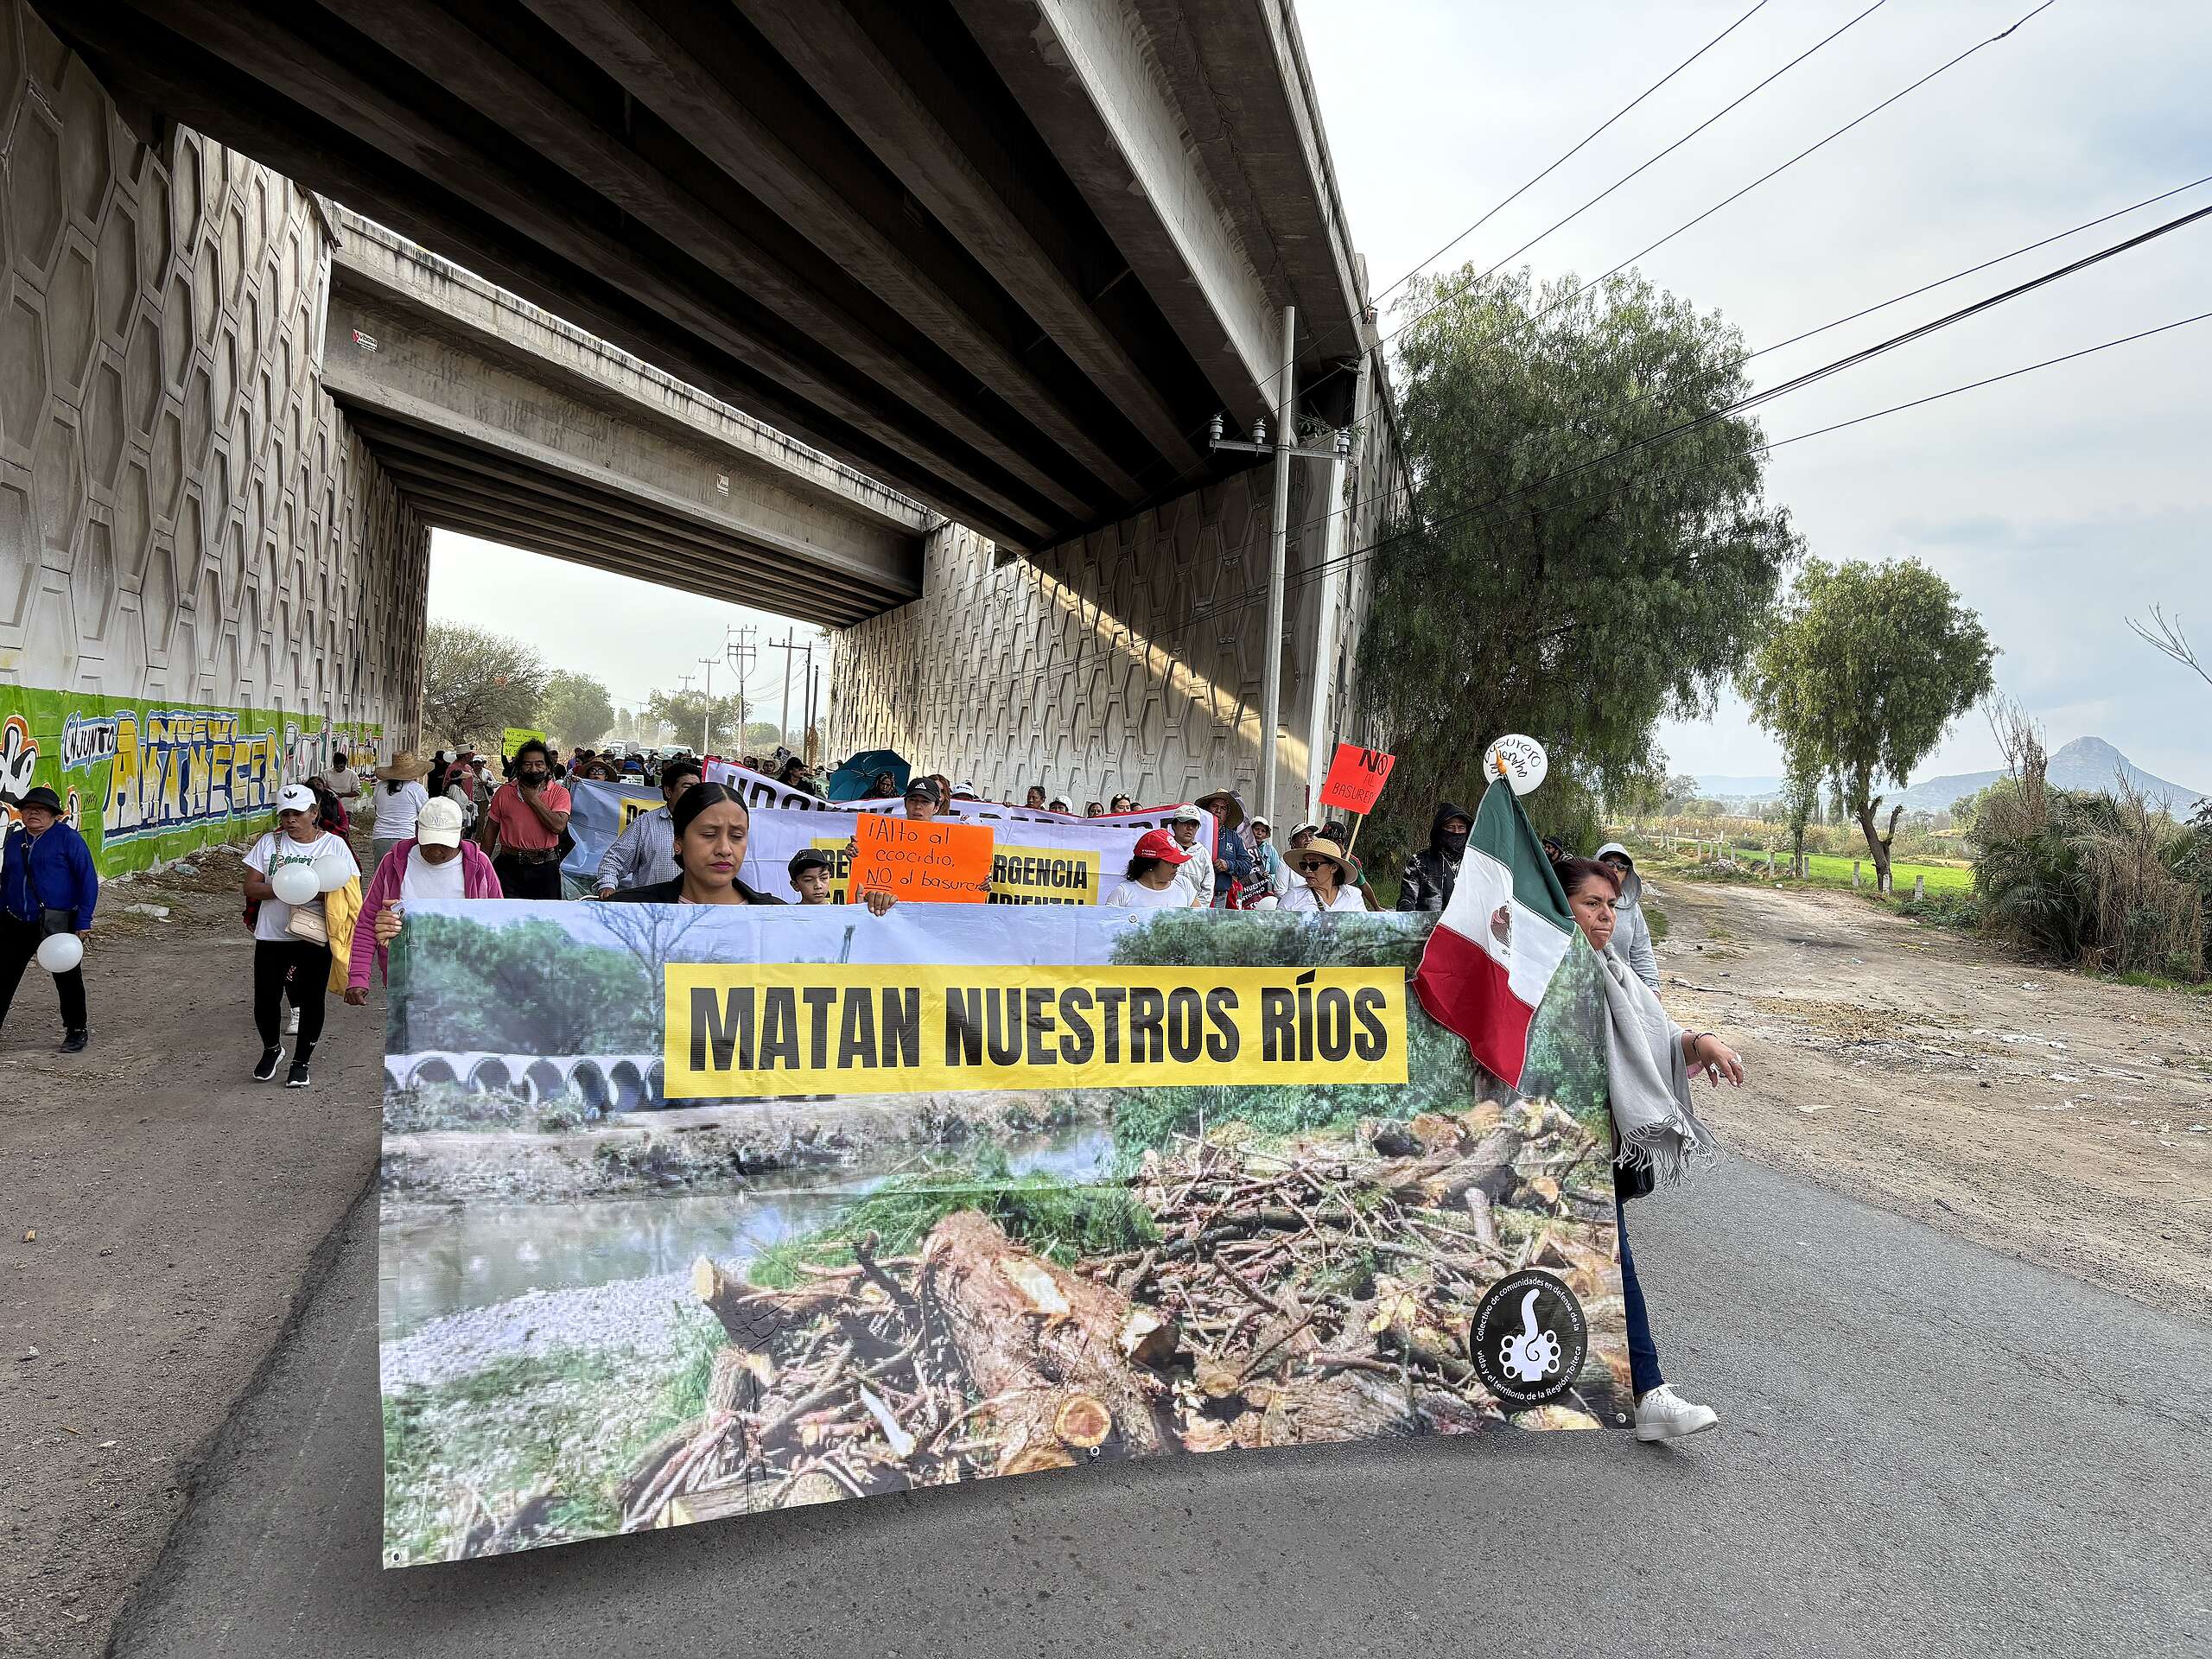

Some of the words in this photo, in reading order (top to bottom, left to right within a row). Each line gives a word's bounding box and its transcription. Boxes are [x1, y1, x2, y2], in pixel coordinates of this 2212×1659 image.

[147, 718, 238, 745] NUEVO
[1358, 749, 1389, 775] NO
[103, 718, 278, 836] AMANECER
[1363, 773, 1375, 787] AL
[929, 827, 950, 844] al
[867, 868, 892, 885] NO
[921, 870, 982, 892] basurer
[992, 854, 1088, 889] RGENCIA
[690, 986, 920, 1071] MATAN
[944, 986, 1239, 1067] NUESTROS
[1261, 969, 1388, 1064] RÍOS
[1499, 1277, 1544, 1296] comunidades
[1544, 1281, 1553, 1291] en
[1491, 1295, 1501, 1306] de
[1553, 1286, 1573, 1312] defensa
[1476, 1305, 1493, 1342] Colectivo
[1570, 1312, 1578, 1323] de
[1573, 1323, 1580, 1332] la
[1477, 1350, 1487, 1370] vida
[1487, 1375, 1497, 1383] el
[1493, 1380, 1525, 1400] territorio
[1526, 1391, 1537, 1401] de
[1537, 1390, 1546, 1399] la
[1545, 1375, 1570, 1396] Región
[1566, 1345, 1581, 1376] Tolteca
